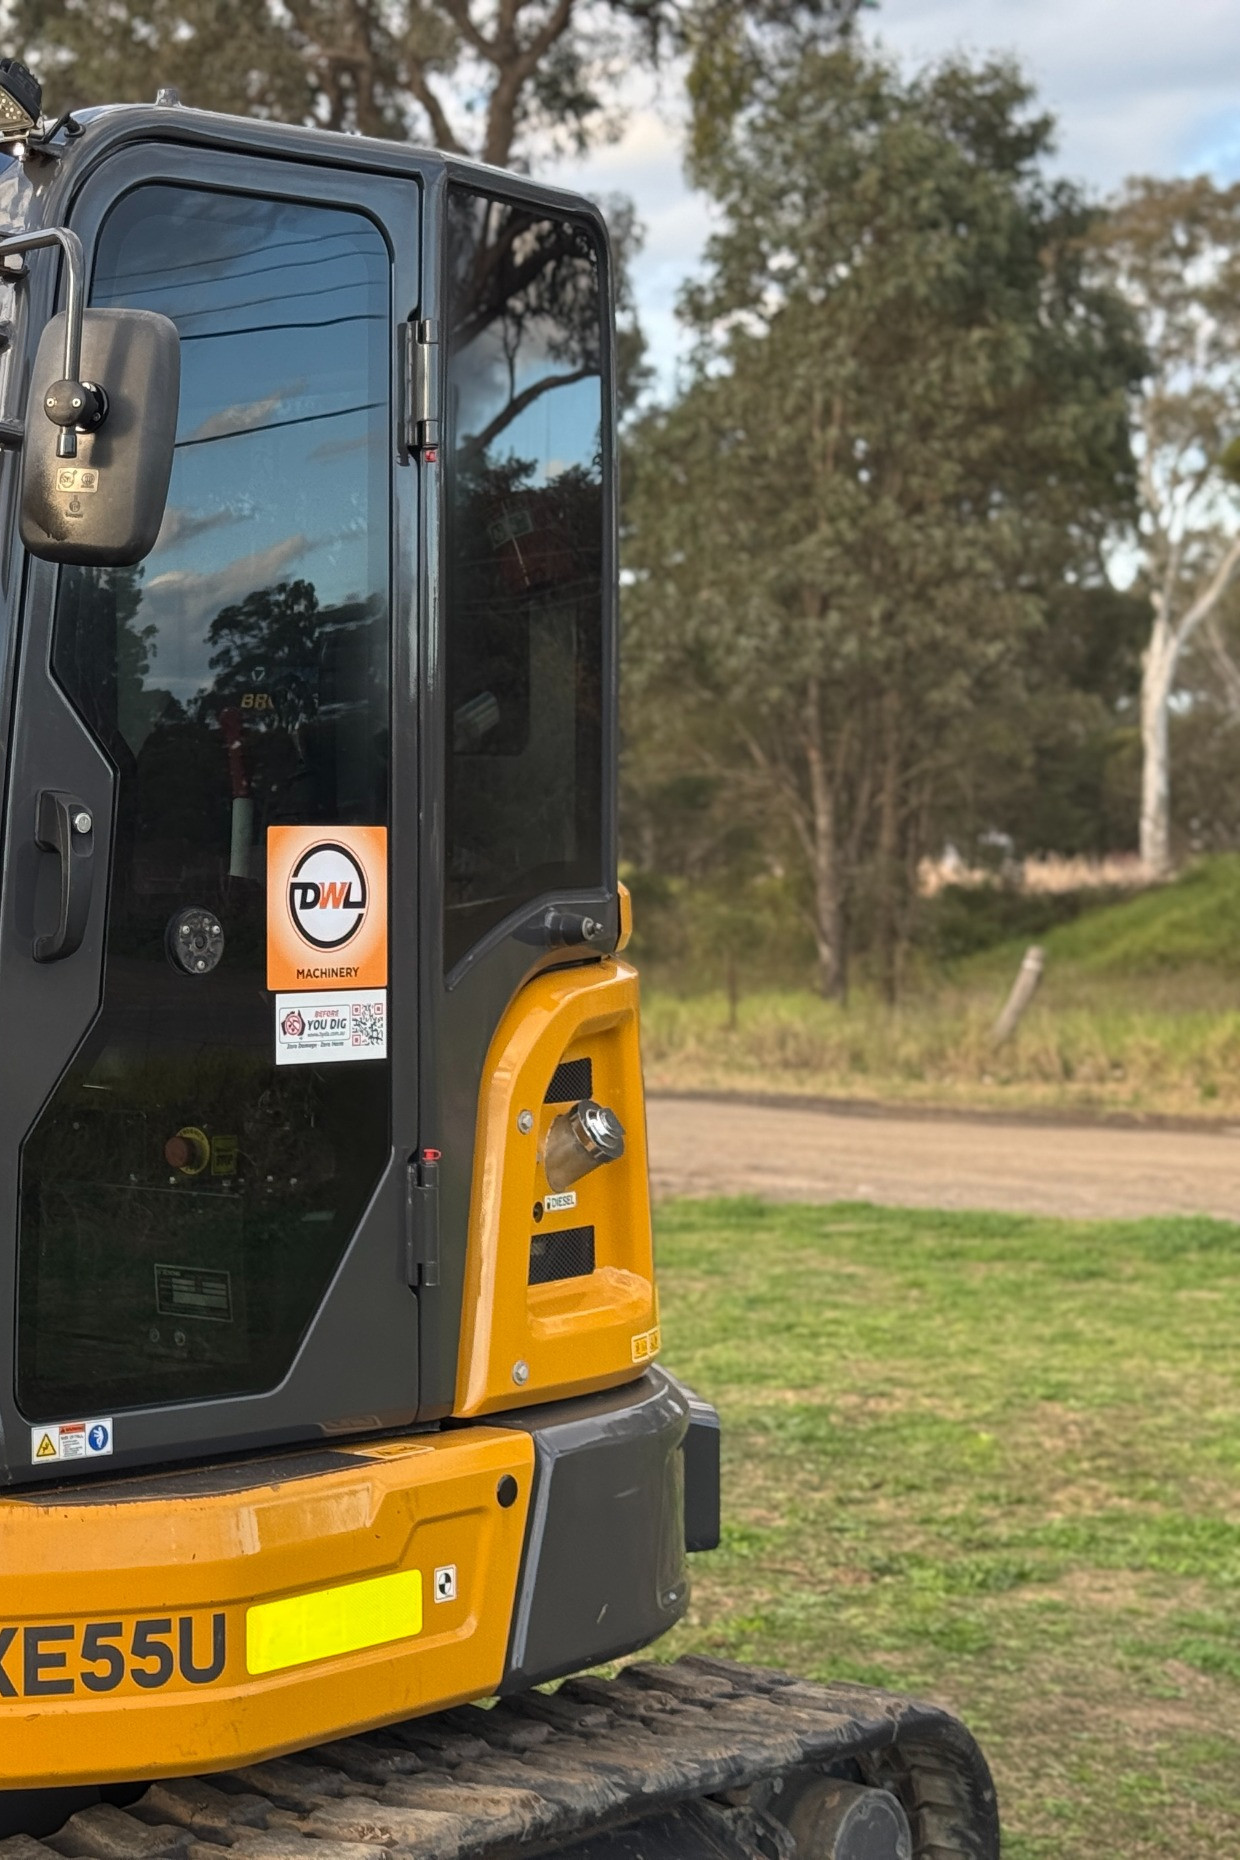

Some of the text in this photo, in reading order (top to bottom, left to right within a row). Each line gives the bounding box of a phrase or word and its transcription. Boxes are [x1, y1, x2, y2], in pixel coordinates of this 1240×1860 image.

[291, 881, 365, 910] DWL
[296, 966, 360, 980] MACHINERY
[314, 1009, 339, 1018] BEFORE
[307, 1018, 347, 1031] YOU DIG
[551, 1194, 575, 1208] DIESEL
